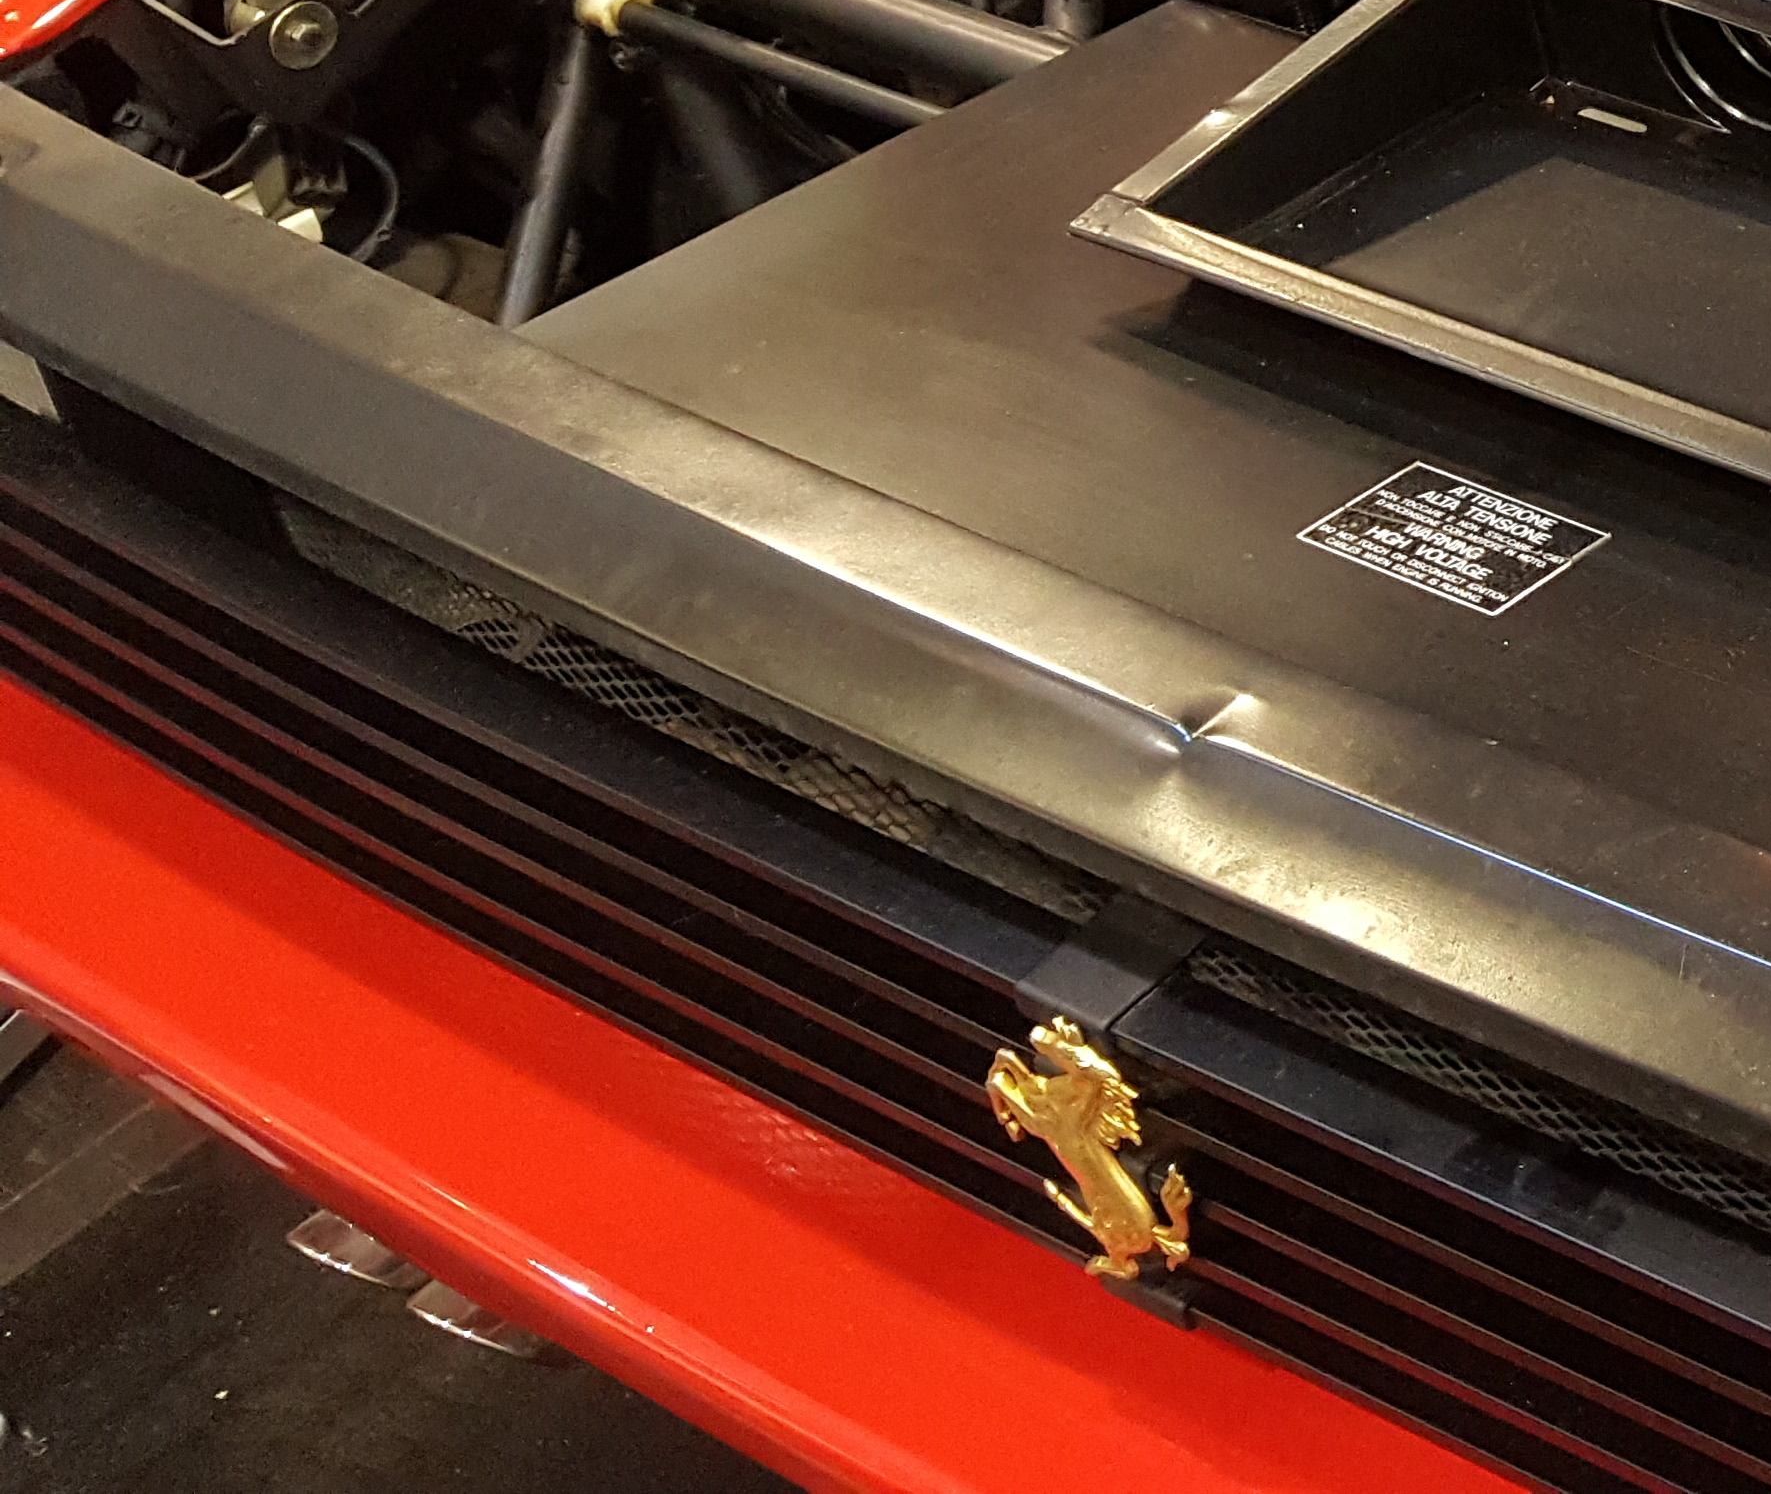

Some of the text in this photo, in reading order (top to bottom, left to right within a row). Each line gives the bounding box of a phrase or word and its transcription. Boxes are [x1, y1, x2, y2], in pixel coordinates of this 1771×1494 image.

[1375, 489, 1401, 500] NON
[1399, 498, 1446, 518] TOCCARE
[1454, 519, 1481, 532] NON
[1482, 530, 1533, 552] STACCARE
[1416, 489, 1552, 544] ALTA TENSIONE
[1447, 483, 1560, 530] ATTENZIONE
[1317, 524, 1509, 602] DO NOT TOUCH OR DISCONNECT IGNITION
[1323, 536, 1364, 554] CABLES
[1361, 551, 1393, 566] WHEN
[1391, 563, 1428, 580] ENGINE
[1426, 577, 1441, 585] IS
[1363, 525, 1494, 580] HIGH VOLTAGE
[1400, 522, 1487, 559] WARNING
[1440, 524, 1467, 536] CON
[1464, 533, 1506, 551] MOTORE
[1502, 548, 1517, 556] IN
